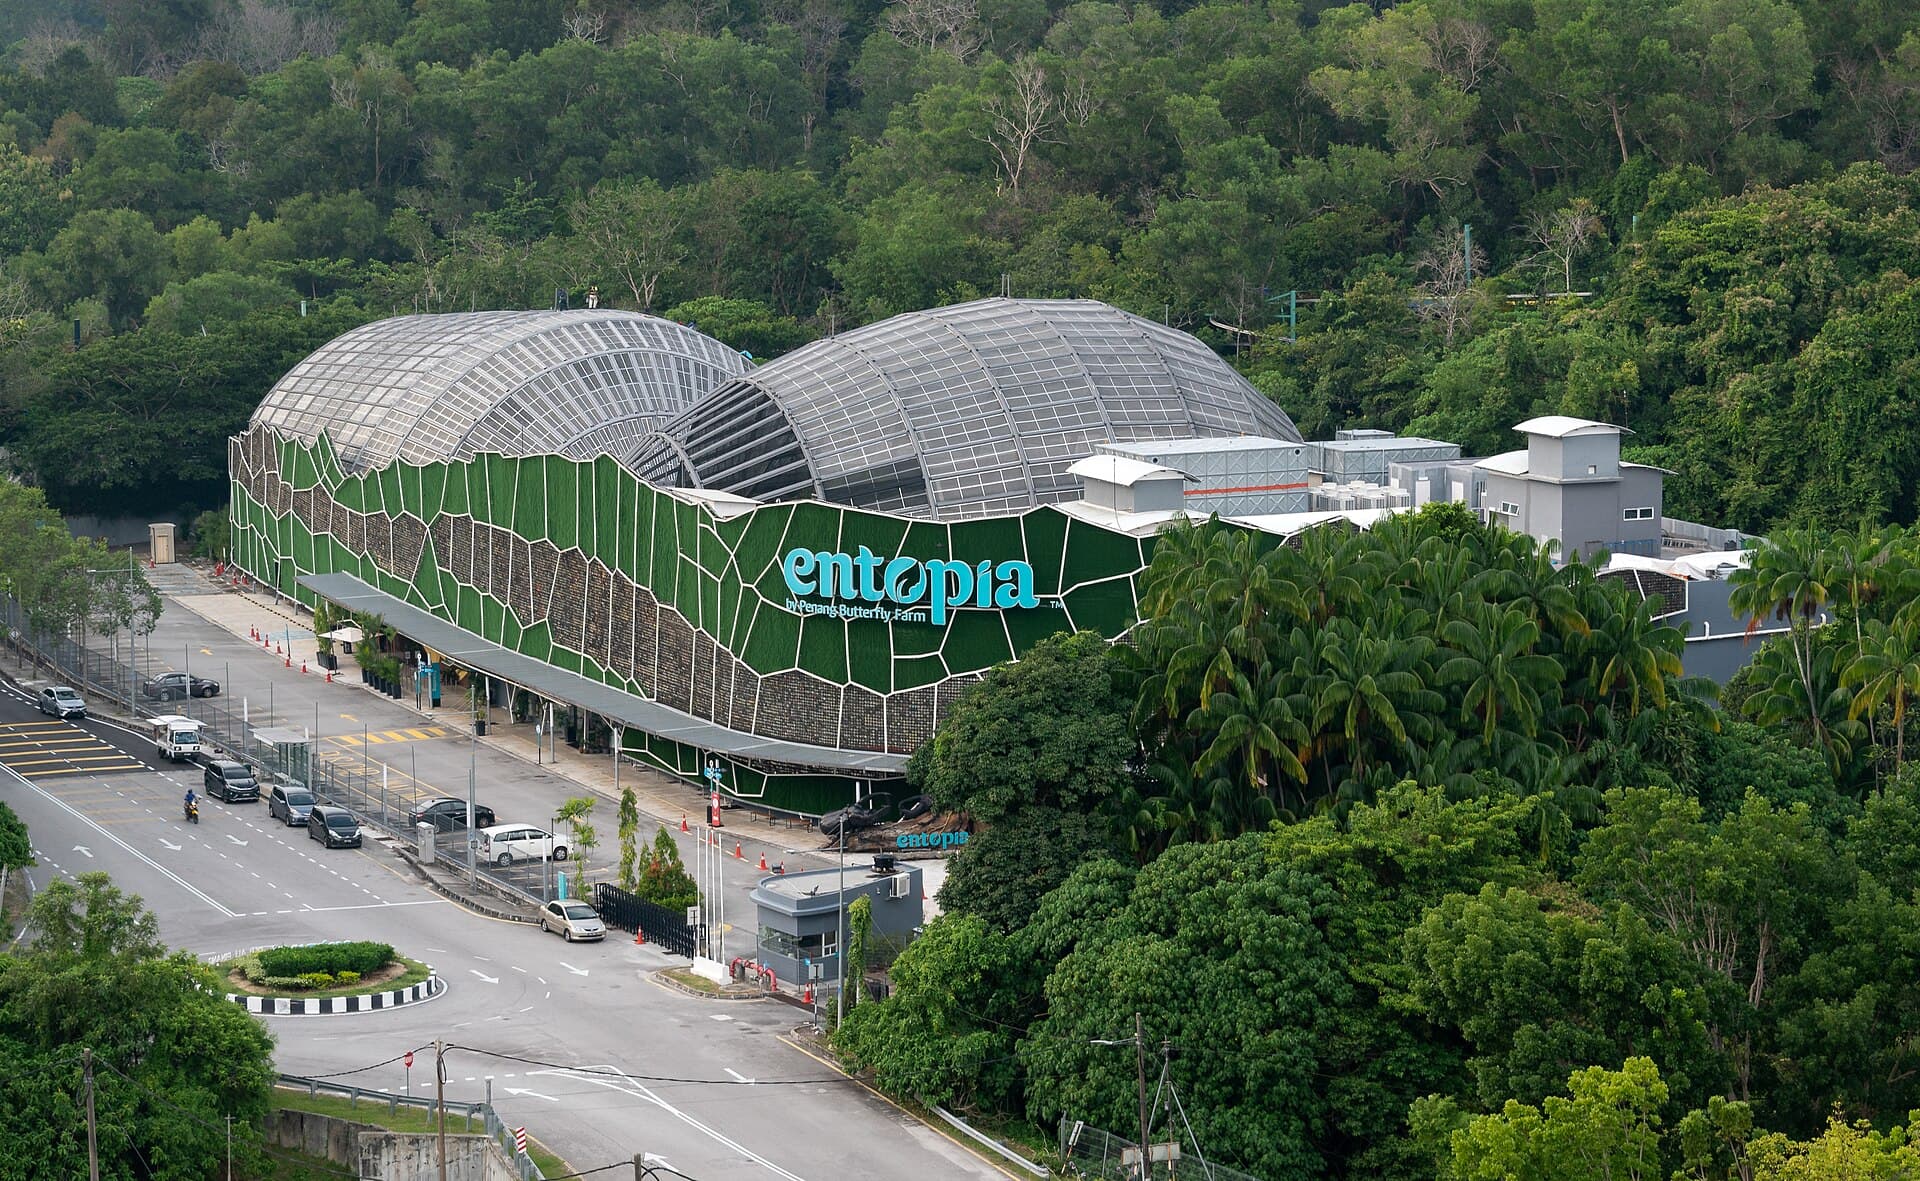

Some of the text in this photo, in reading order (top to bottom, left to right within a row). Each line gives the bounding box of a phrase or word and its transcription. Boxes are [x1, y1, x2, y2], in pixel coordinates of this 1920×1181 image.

[783, 545, 1040, 625] entopia
[785, 598, 926, 623] by Penang Butterfly Farm
[896, 831, 969, 850] entopia
